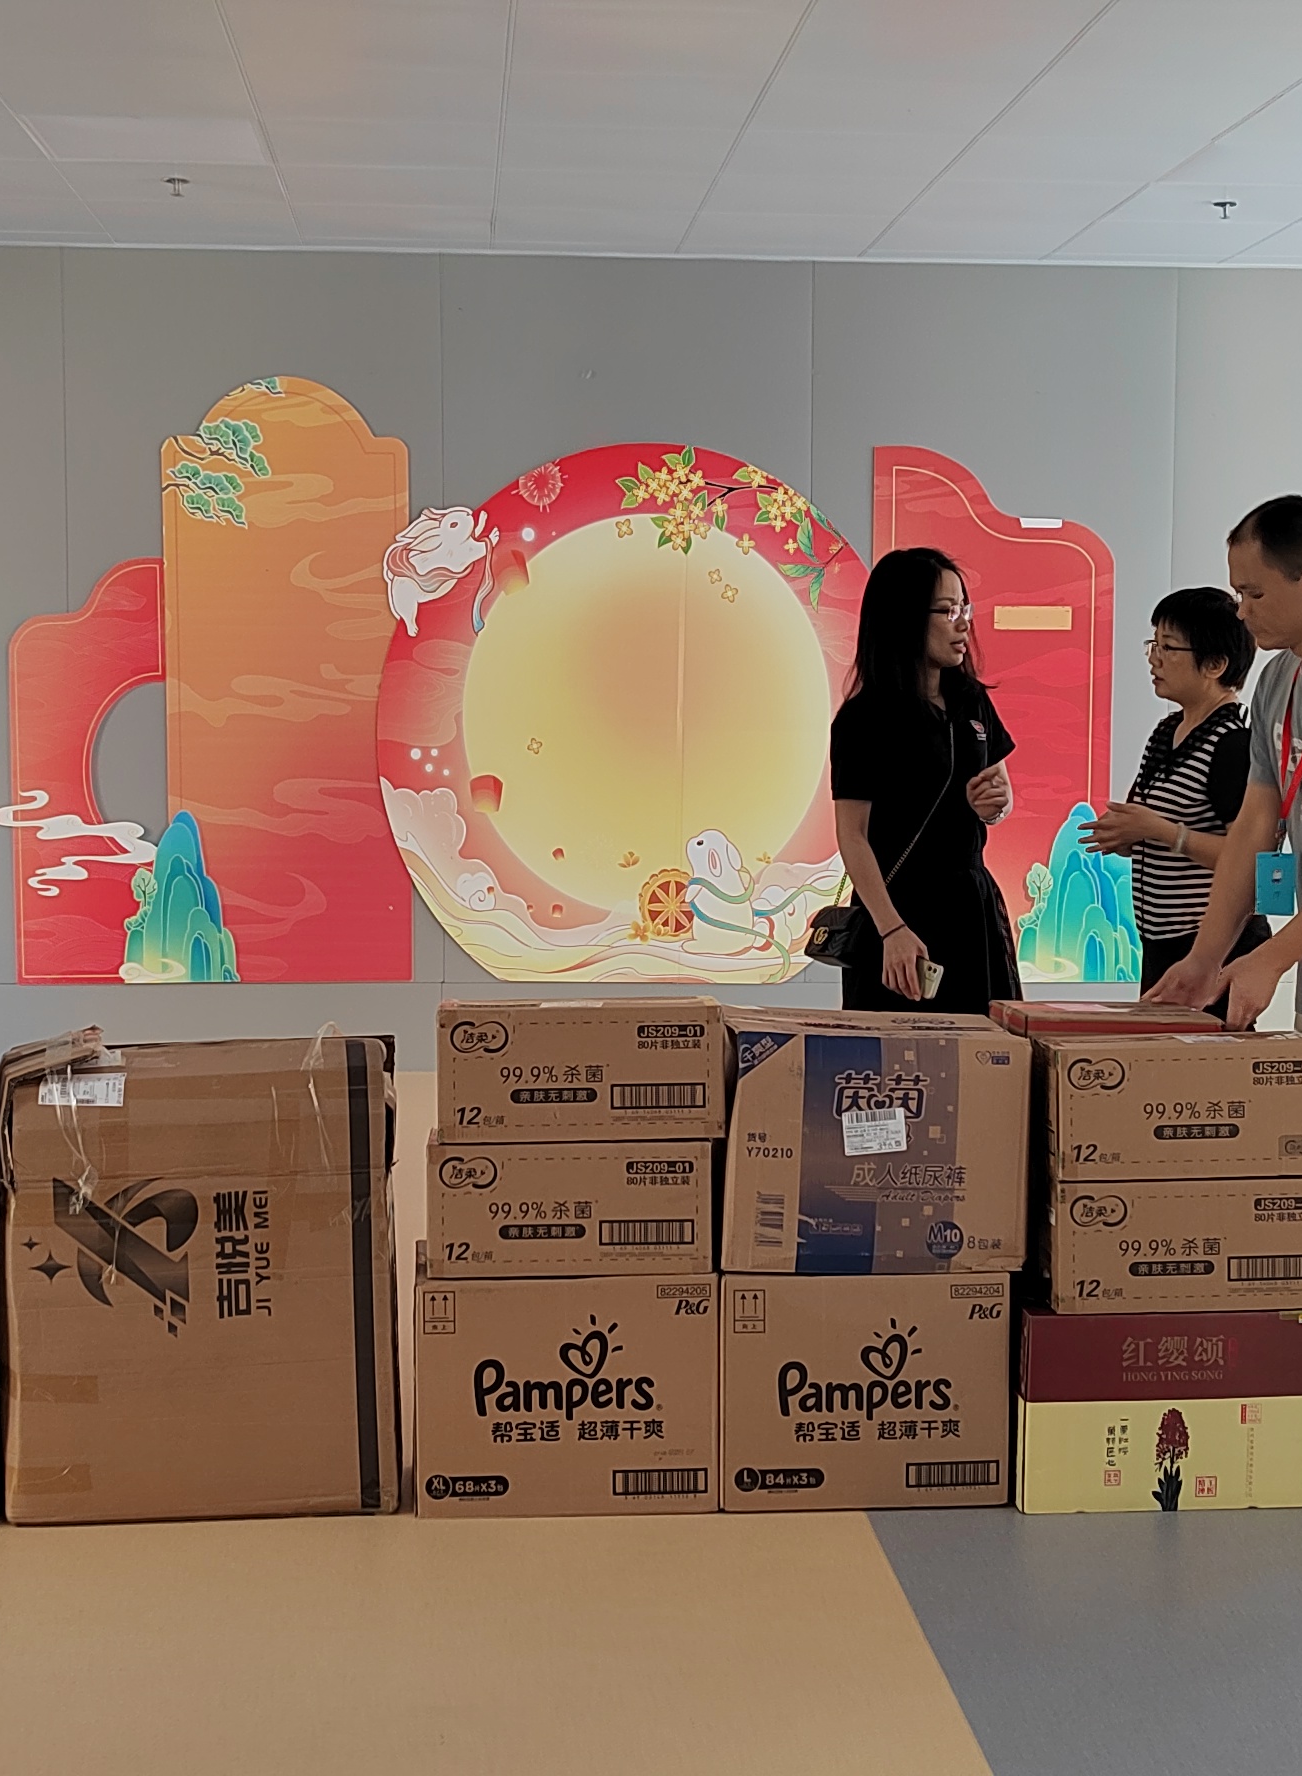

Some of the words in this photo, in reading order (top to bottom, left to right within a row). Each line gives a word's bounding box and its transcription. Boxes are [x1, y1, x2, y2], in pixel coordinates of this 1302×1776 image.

[640, 1025, 702, 1038] JS209-01
[637, 1039, 701, 1050] 80片非独立装
[746, 1147, 793, 1159] Y70210
[629, 1162, 691, 1174] JS209-01
[851, 1162, 967, 1187] 成人纸尿裤
[626, 1175, 690, 1187] 80片非独立装
[252, 1190, 269, 1229] MEI
[213, 1190, 252, 1319] 吉悦美
[255, 1241, 271, 1286] YUE
[660, 1286, 708, 1297] 82294205
[953, 1285, 1001, 1297] 82294204
[256, 1297, 272, 1317] JI
[674, 1299, 710, 1316] P&G
[968, 1303, 1003, 1319] P&G
[1121, 1335, 1225, 1368] 红缨颂
[1122, 1371, 1157, 1382] HONG
[1159, 1370, 1189, 1382] YING
[1191, 1370, 1224, 1381] SONG
[474, 1359, 655, 1421] Pampers
[777, 1361, 952, 1420] Pampers
[491, 1420, 561, 1443] 帮宝适
[577, 1418, 665, 1441] 超薄干爽
[794, 1421, 861, 1443] 帮宝适
[877, 1419, 961, 1441] 超薄干爽
[431, 1477, 446, 1490] XL
[743, 1469, 752, 1483] L
